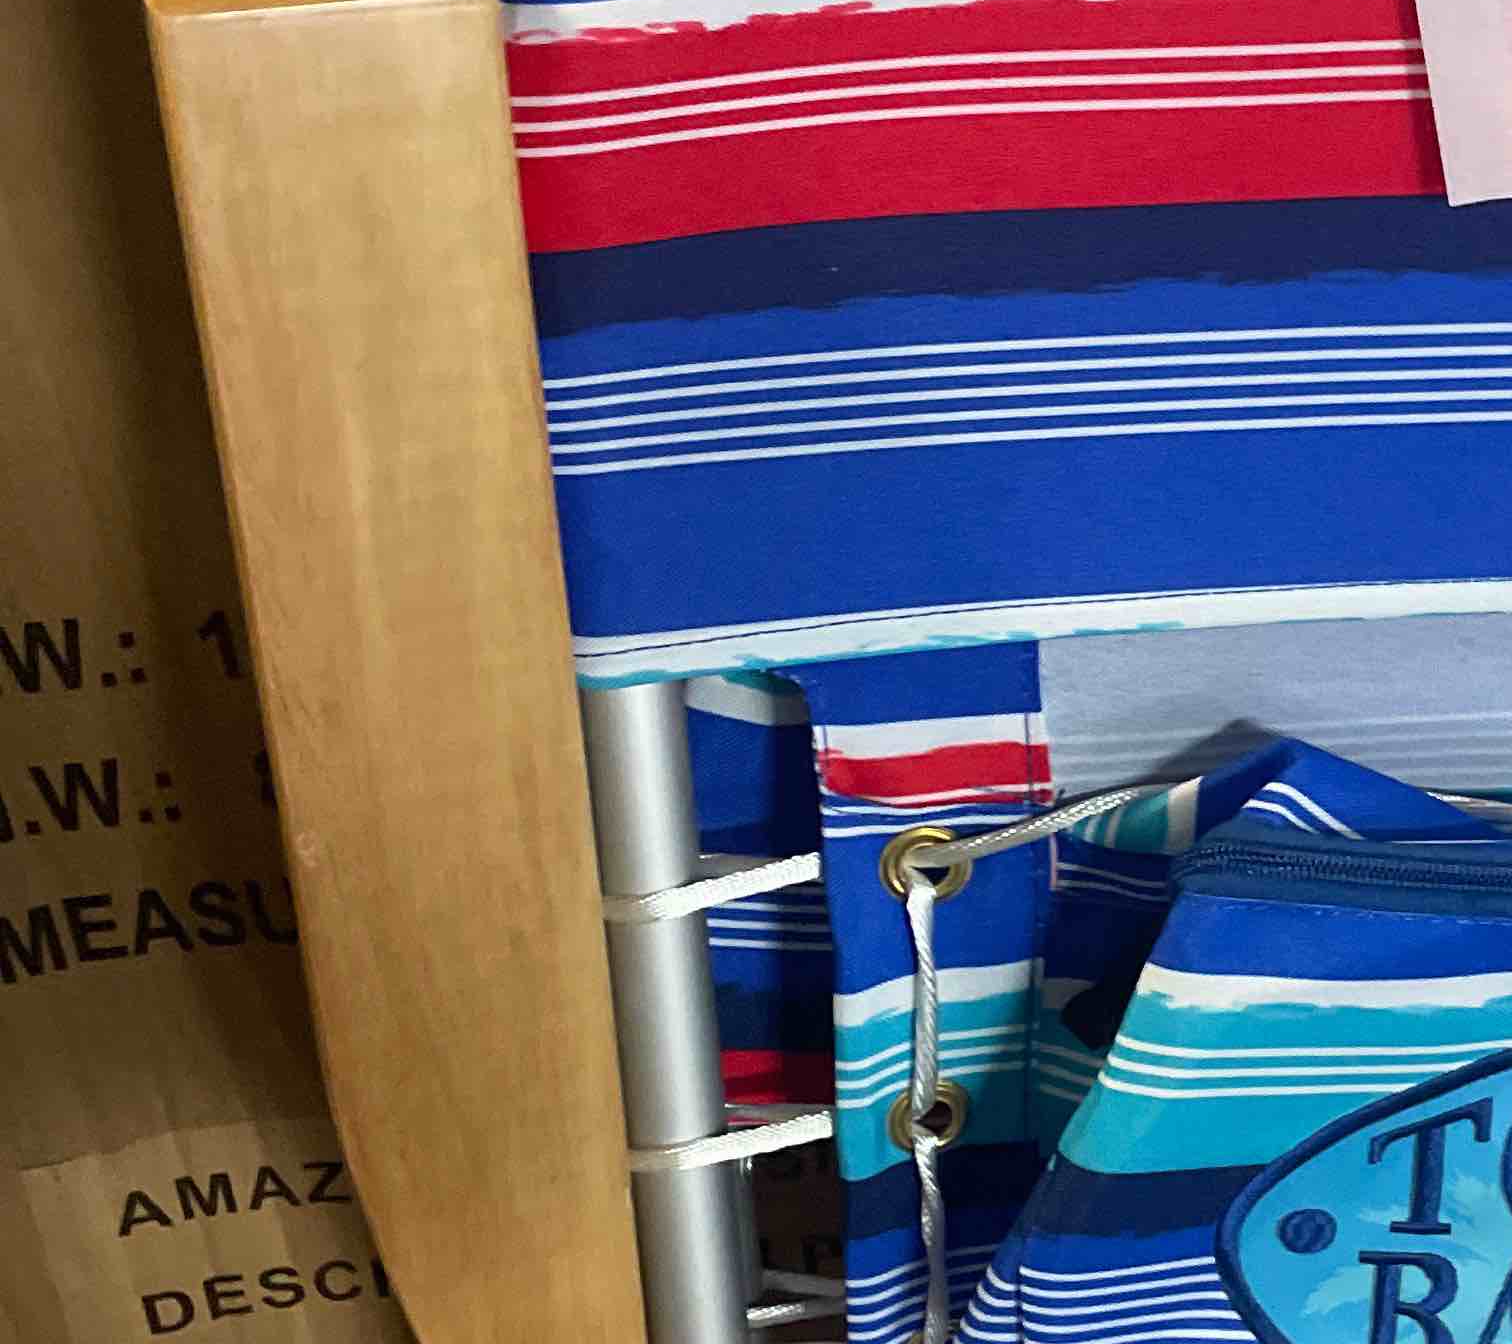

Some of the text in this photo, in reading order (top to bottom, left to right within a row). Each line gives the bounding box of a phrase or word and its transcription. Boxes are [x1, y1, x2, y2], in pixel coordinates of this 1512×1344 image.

[0, 756, 182, 843] .W.:
[0, 877, 299, 985] MEASU
[117, 1158, 351, 1238] AMAZ
